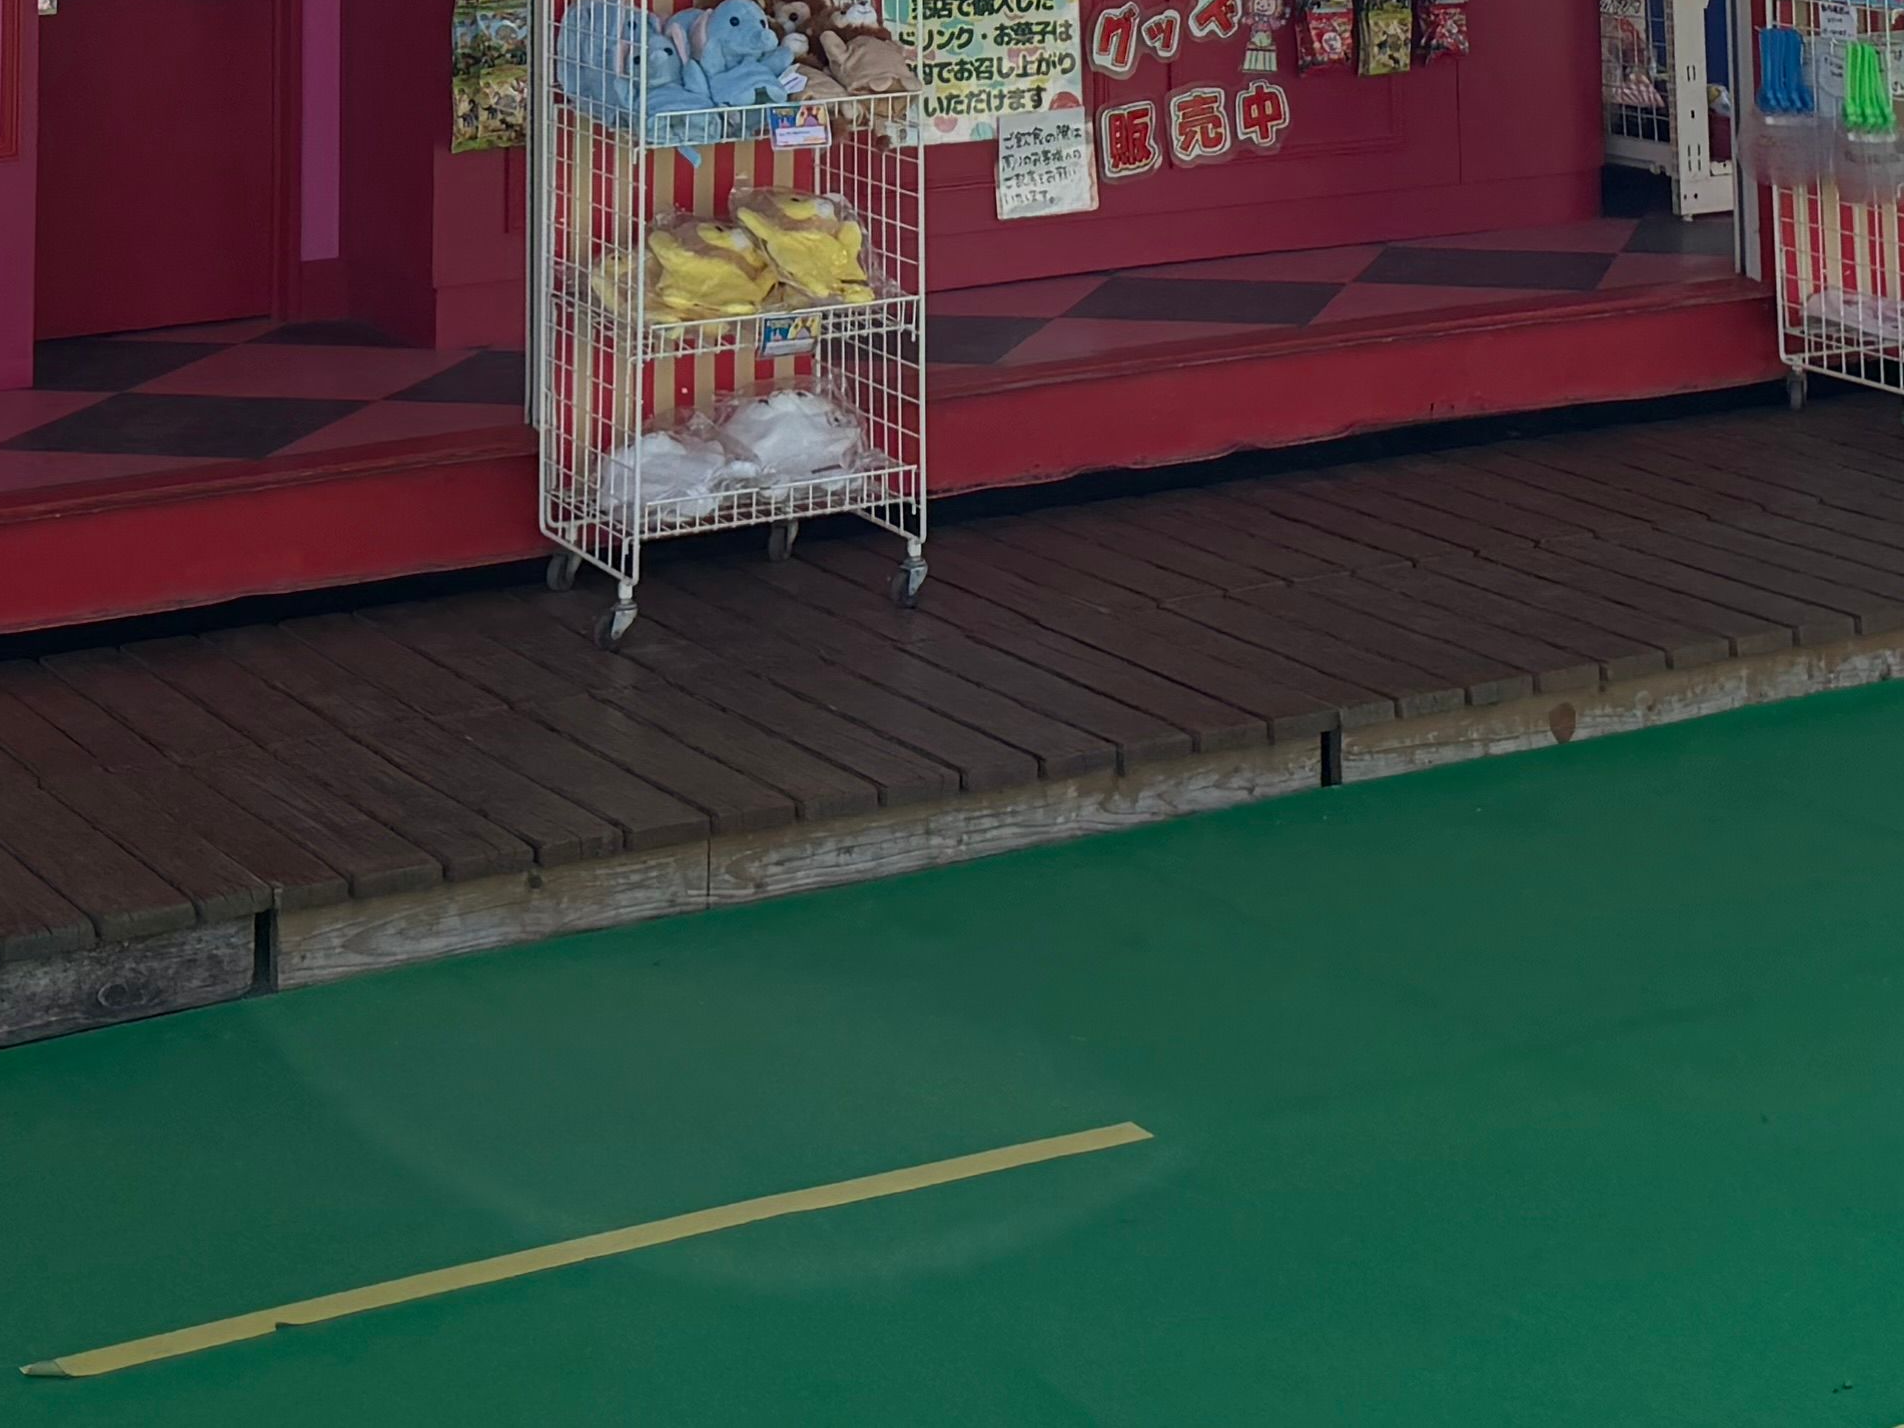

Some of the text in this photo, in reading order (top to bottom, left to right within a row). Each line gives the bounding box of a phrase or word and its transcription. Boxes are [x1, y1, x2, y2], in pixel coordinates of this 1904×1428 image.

[923, 85, 1047, 118] いただけます
[1107, 84, 1286, 170] 販売中
